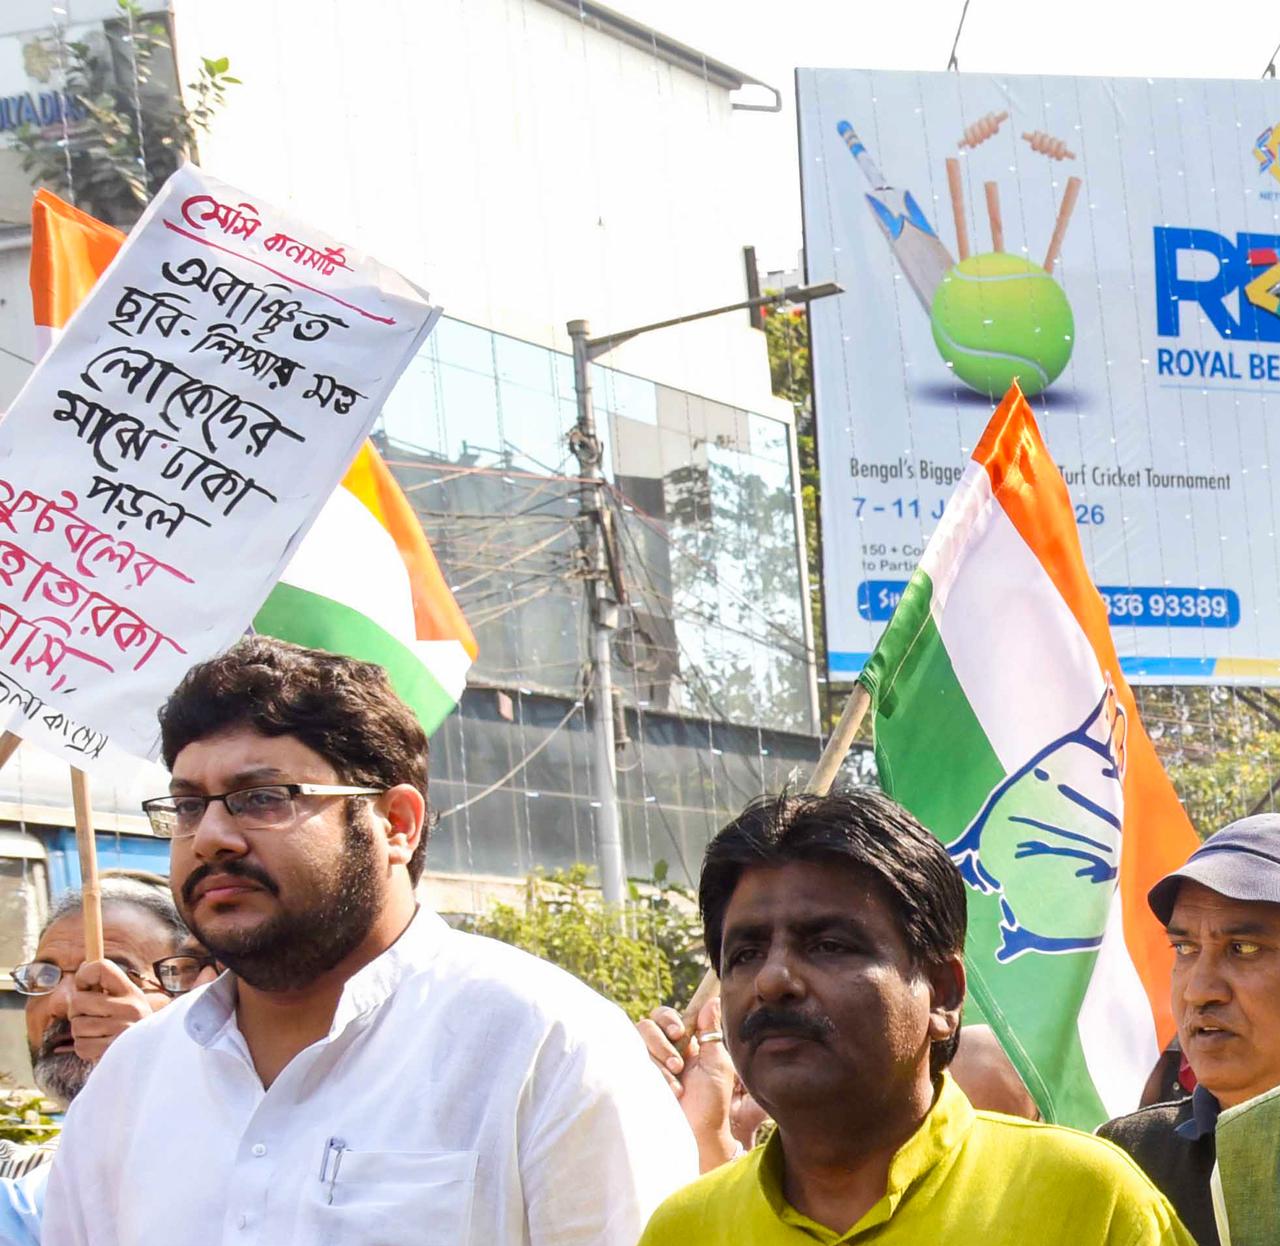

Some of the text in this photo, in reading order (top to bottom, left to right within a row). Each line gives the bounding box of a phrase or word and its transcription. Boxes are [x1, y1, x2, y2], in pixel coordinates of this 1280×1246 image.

[1157, 347, 1243, 380] ROYAL
[850, 457, 915, 484] Bengal's
[919, 459, 967, 486] Bigge
[1092, 465, 1141, 488] Cricket
[1144, 467, 1231, 491] Tournament
[852, 497, 867, 518] 7
[891, 497, 920, 519] 11
[861, 543, 887, 556] 150
[1149, 594, 1229, 618] 93389
